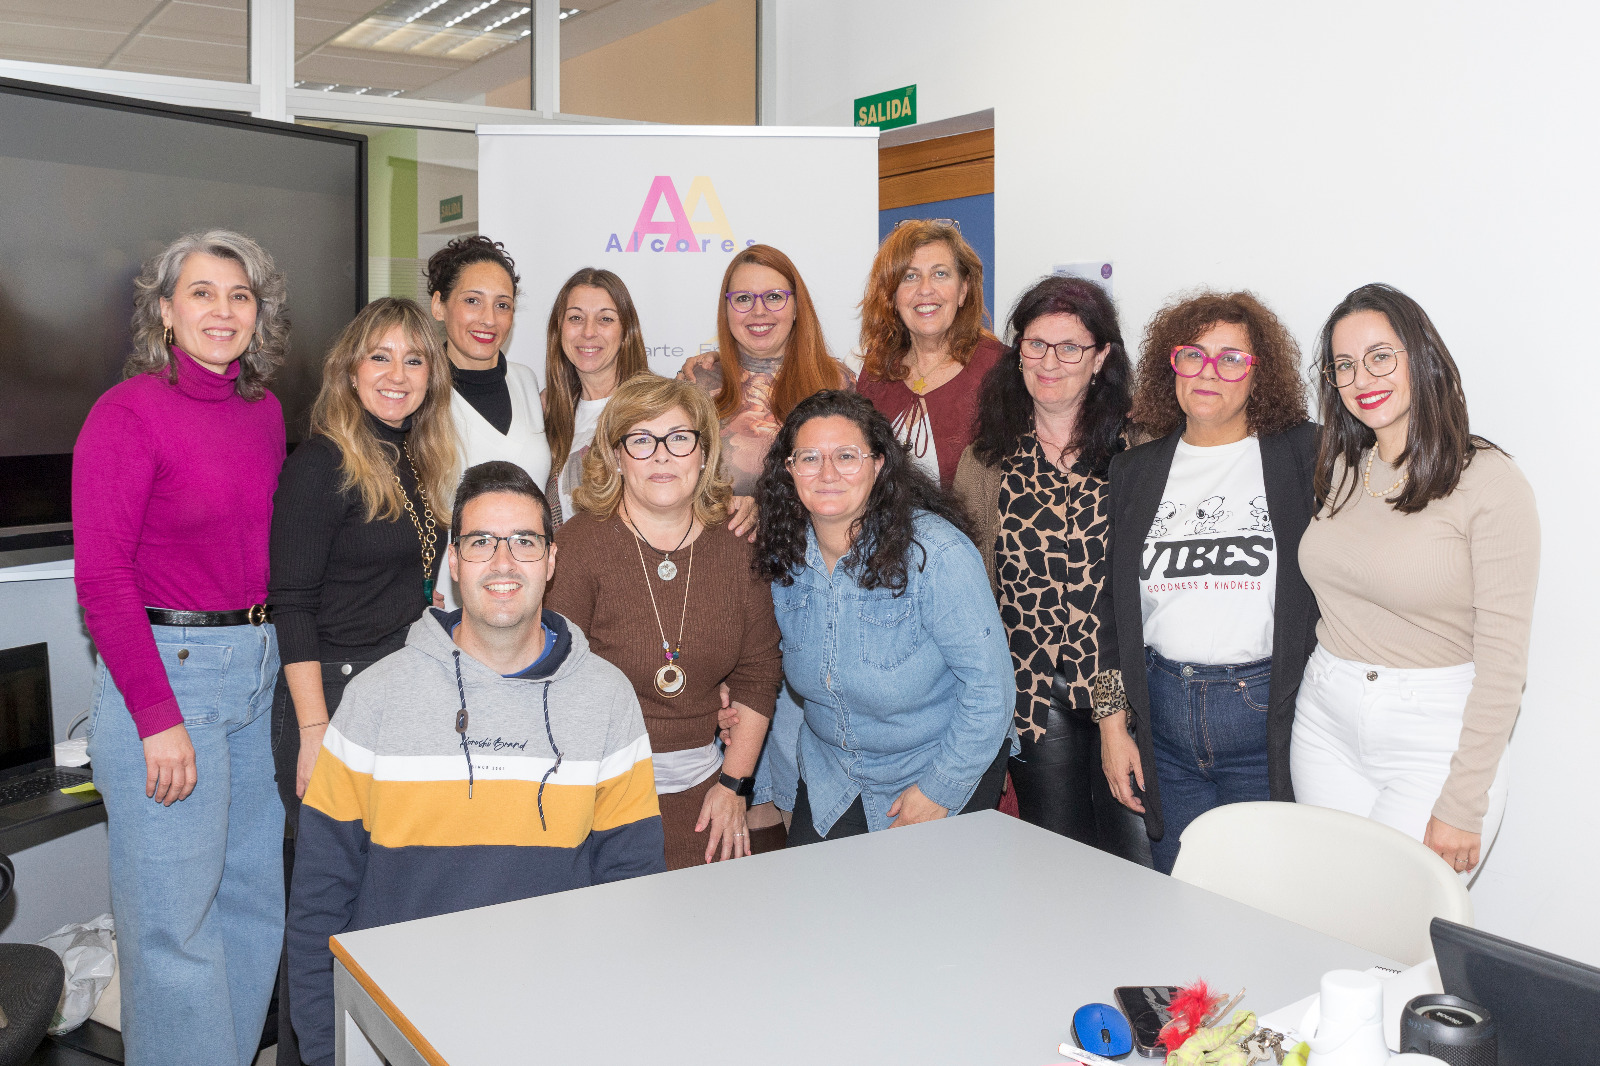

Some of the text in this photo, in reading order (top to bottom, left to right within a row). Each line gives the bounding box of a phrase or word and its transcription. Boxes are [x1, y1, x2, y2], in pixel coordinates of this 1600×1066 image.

[858, 96, 912, 126] SALIDA
[1140, 534, 1274, 581] VIBES
[1147, 580, 1262, 593] GOODNESS & KINDNESS
[493, 736, 529, 752] Brand
